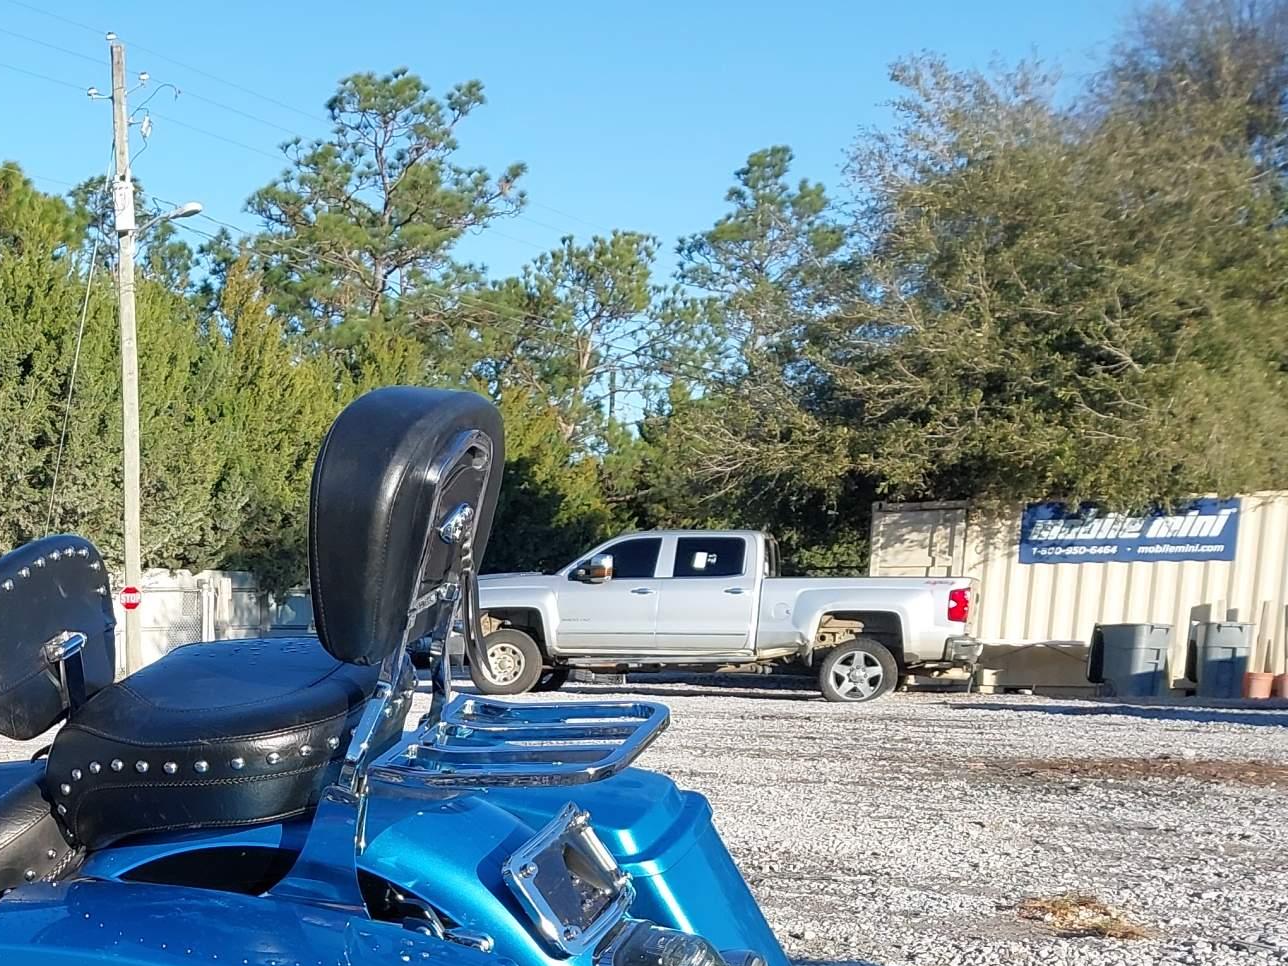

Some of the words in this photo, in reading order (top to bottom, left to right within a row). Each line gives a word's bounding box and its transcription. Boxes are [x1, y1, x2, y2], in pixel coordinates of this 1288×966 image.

[1028, 508, 1144, 540] mobile
[1146, 508, 1237, 538] mini
[1137, 543, 1224, 554] mobilemini.com
[121, 592, 141, 604] STOP
